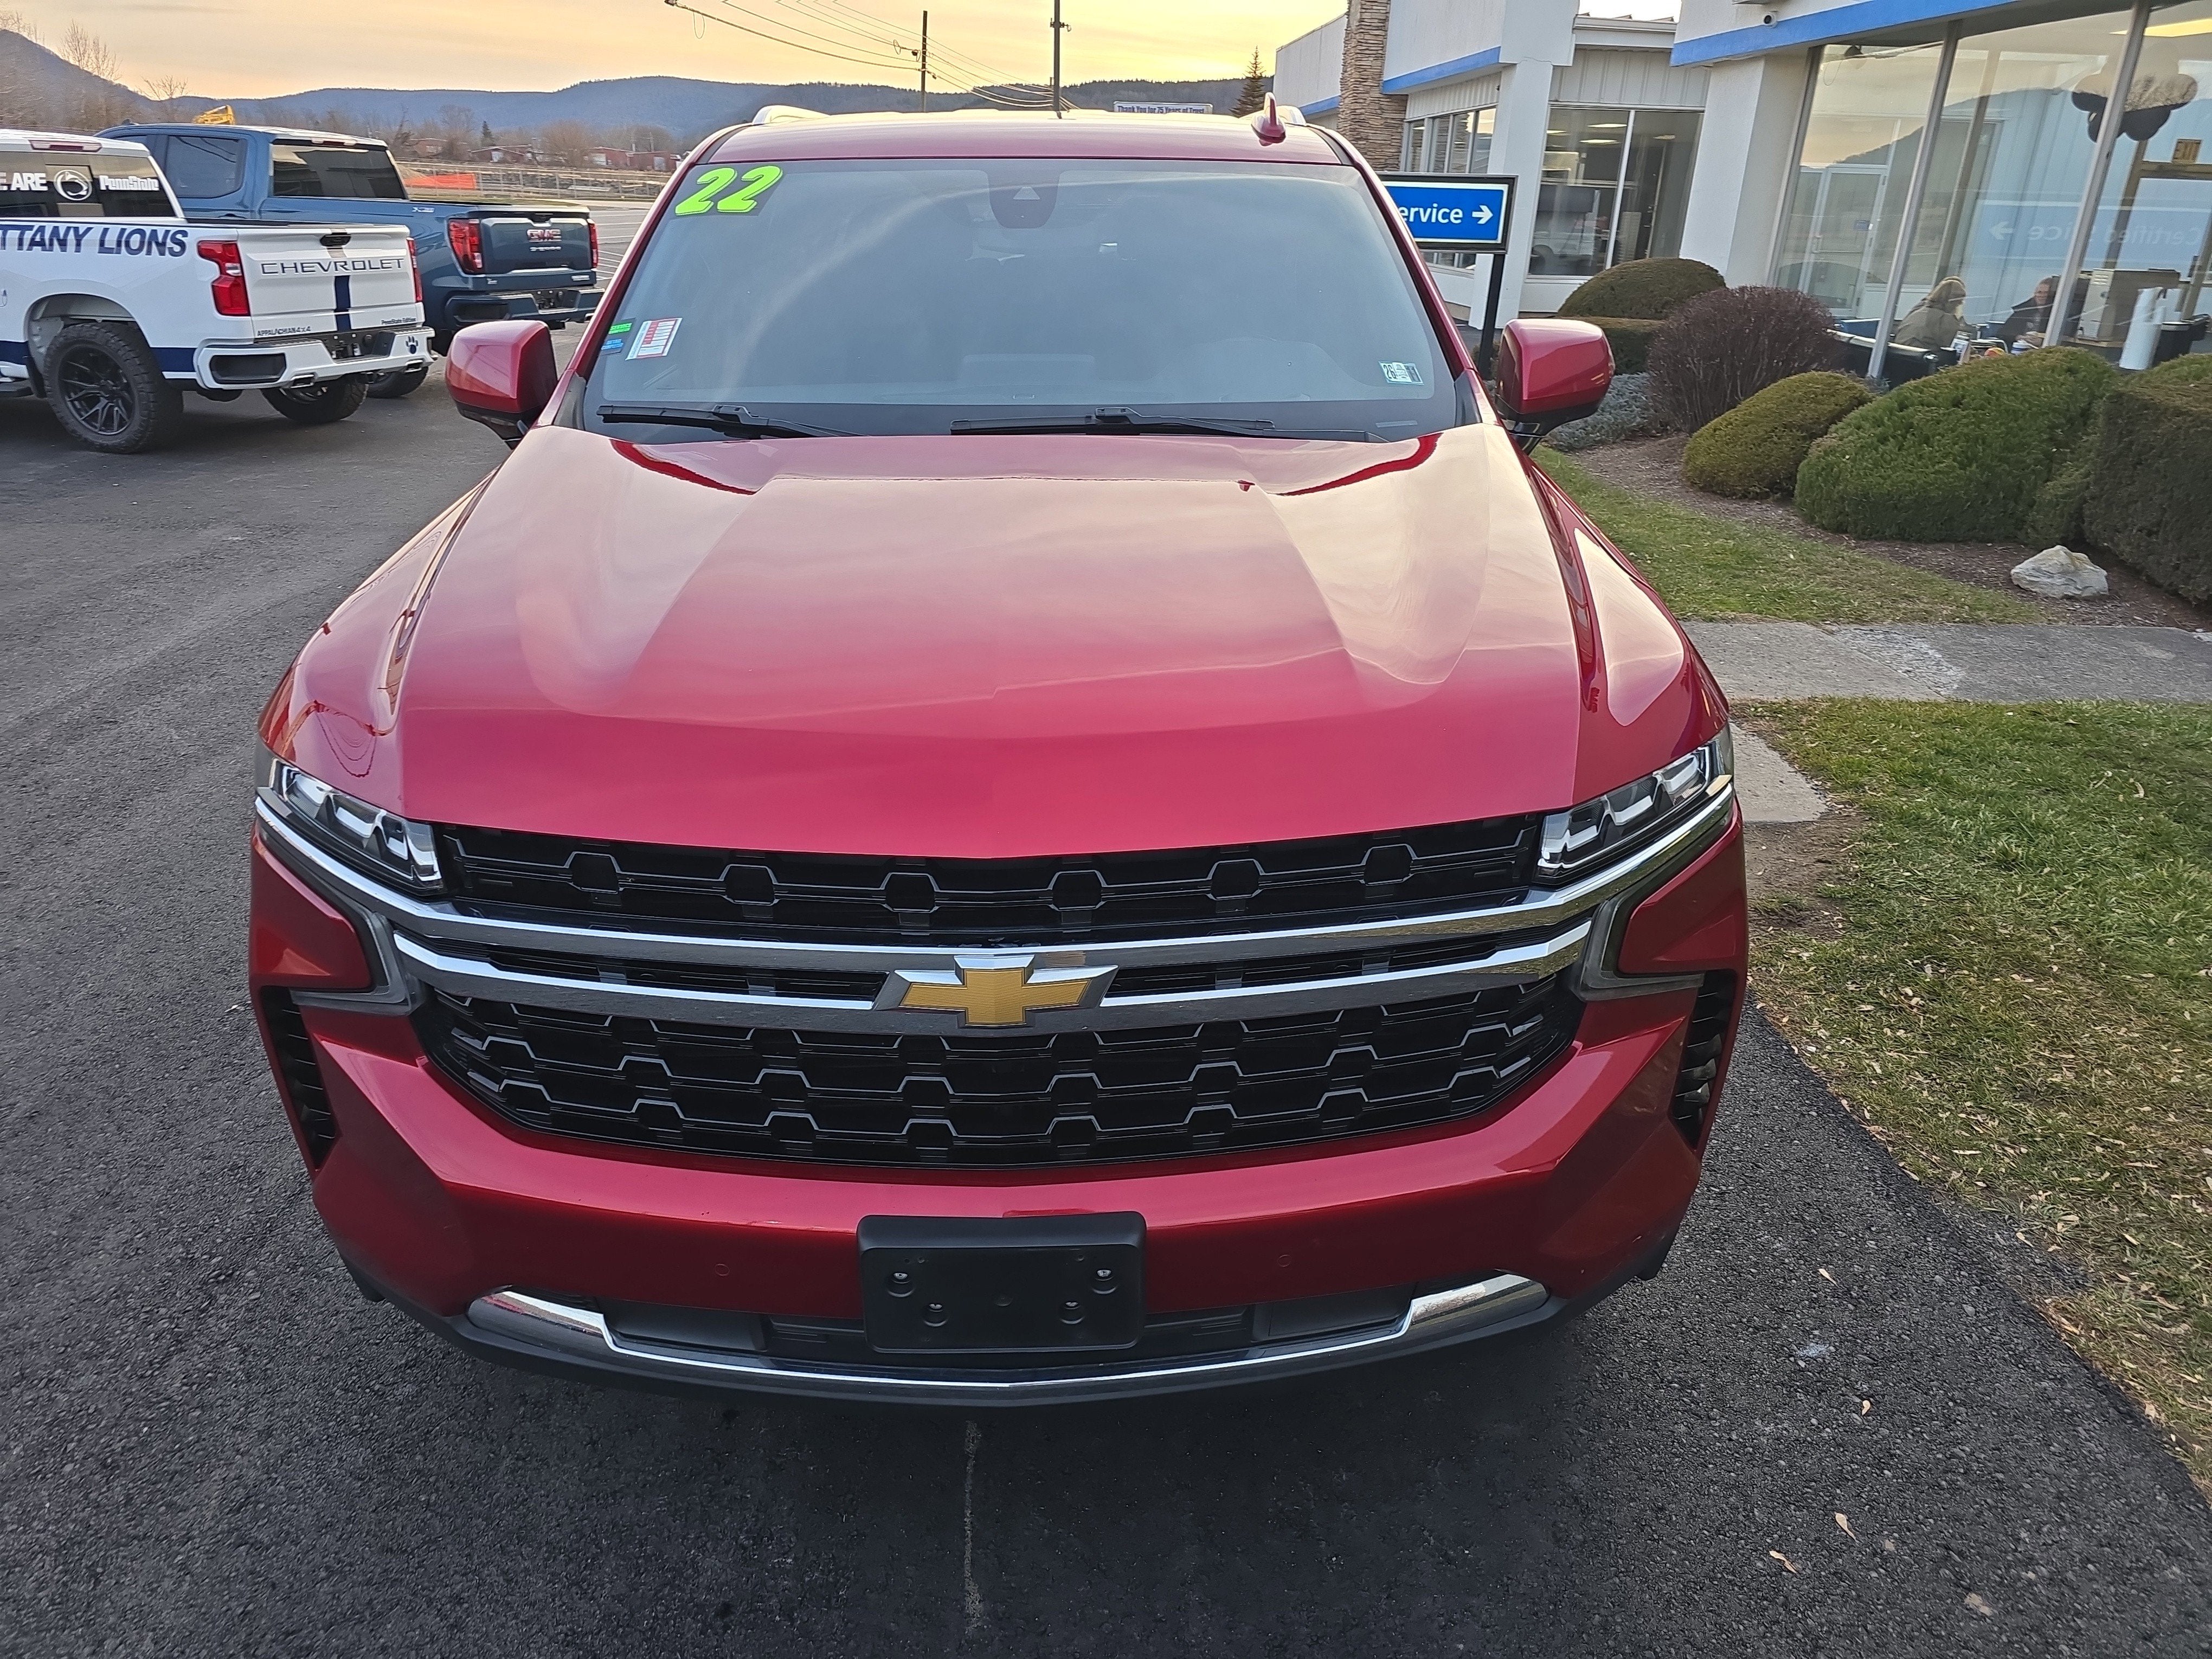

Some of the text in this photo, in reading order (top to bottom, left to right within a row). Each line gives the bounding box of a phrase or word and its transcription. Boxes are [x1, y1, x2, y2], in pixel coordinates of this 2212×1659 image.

[0, 172, 8, 191] E
[10, 172, 48, 191] ARE
[675, 166, 783, 215] 22
[1398, 203, 1463, 224] ervice
[0, 224, 189, 258] TTANY LIONS
[527, 229, 562, 242] GMC
[261, 258, 404, 275] CHEVROLET
[1383, 364, 1397, 380] 26
